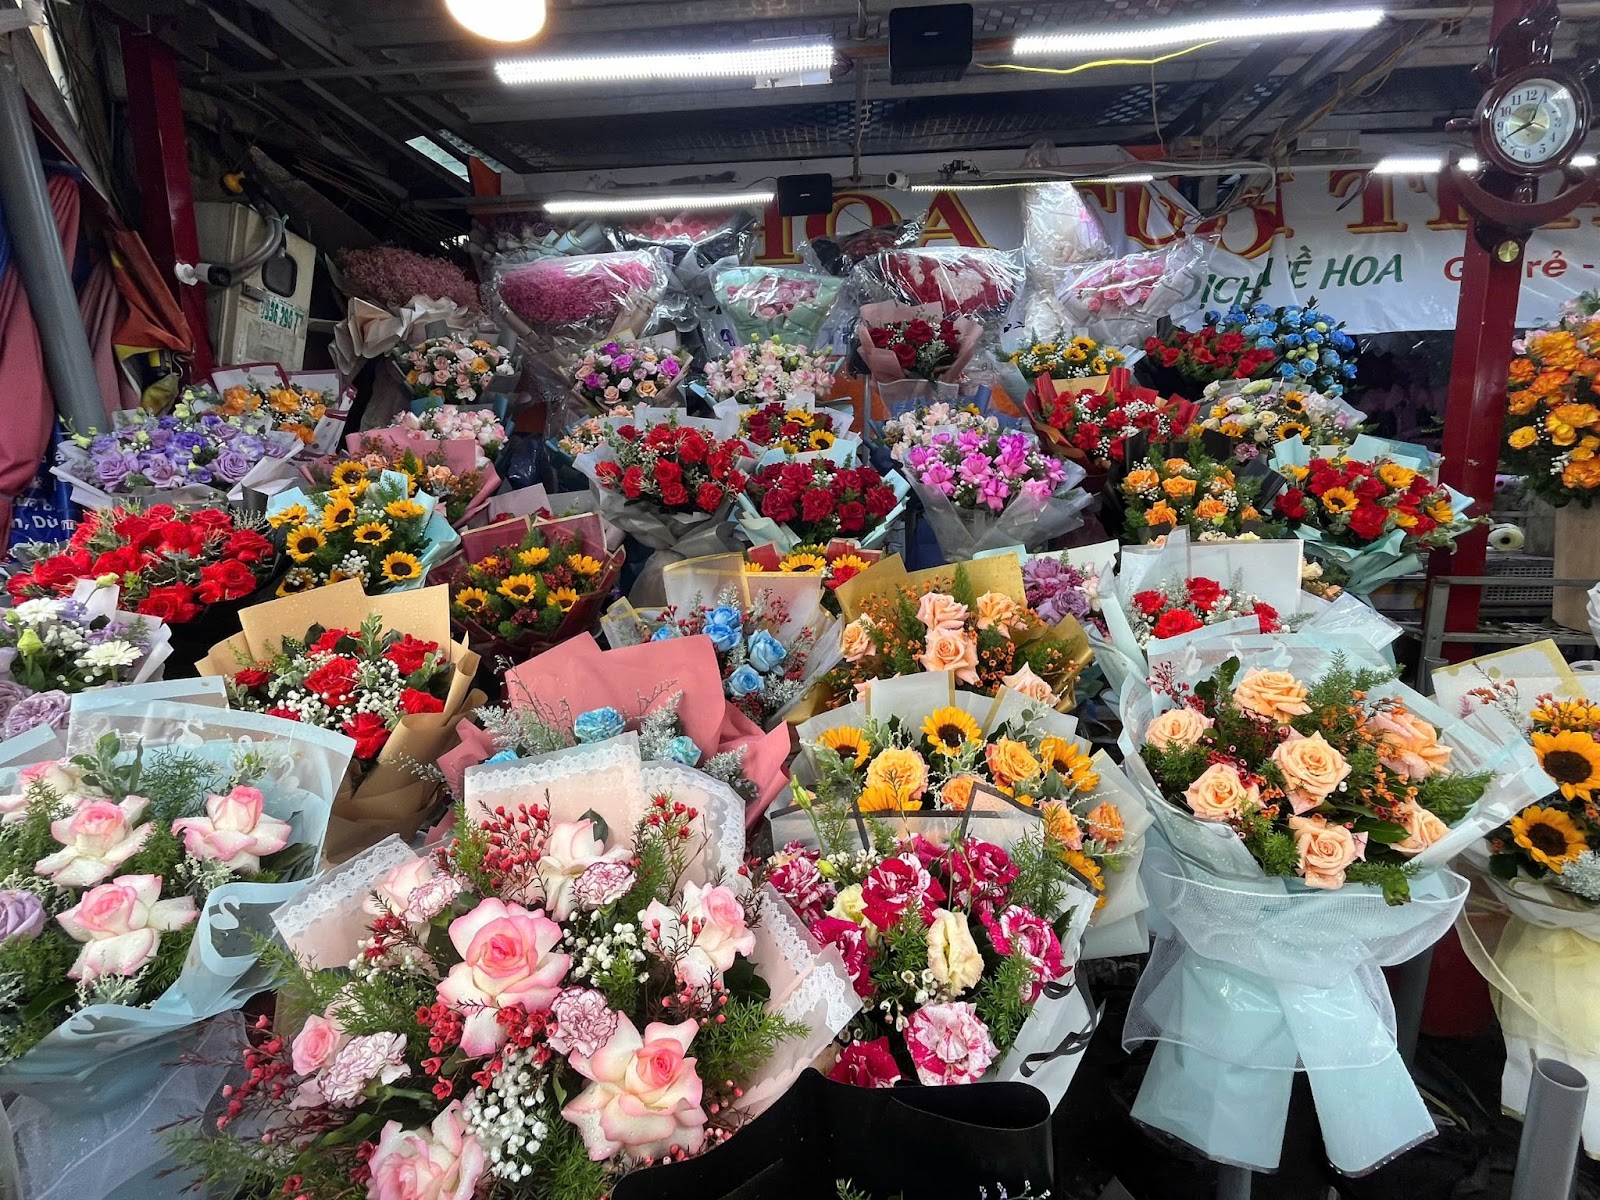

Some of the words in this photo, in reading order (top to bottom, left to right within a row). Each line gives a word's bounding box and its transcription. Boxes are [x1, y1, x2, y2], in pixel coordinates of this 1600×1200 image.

[1511, 95, 1521, 106] 11
[1525, 90, 1537, 101] 12
[1500, 106, 1512, 117] 10
[1497, 121, 1504, 132] 9
[1554, 117, 1562, 128] 3
[1510, 146, 1517, 156] 7
[1524, 149, 1531, 159] 6
[1539, 143, 1546, 154] 5
[1527, 250, 1568, 279] rẻ
[1319, 253, 1404, 291] HOA
